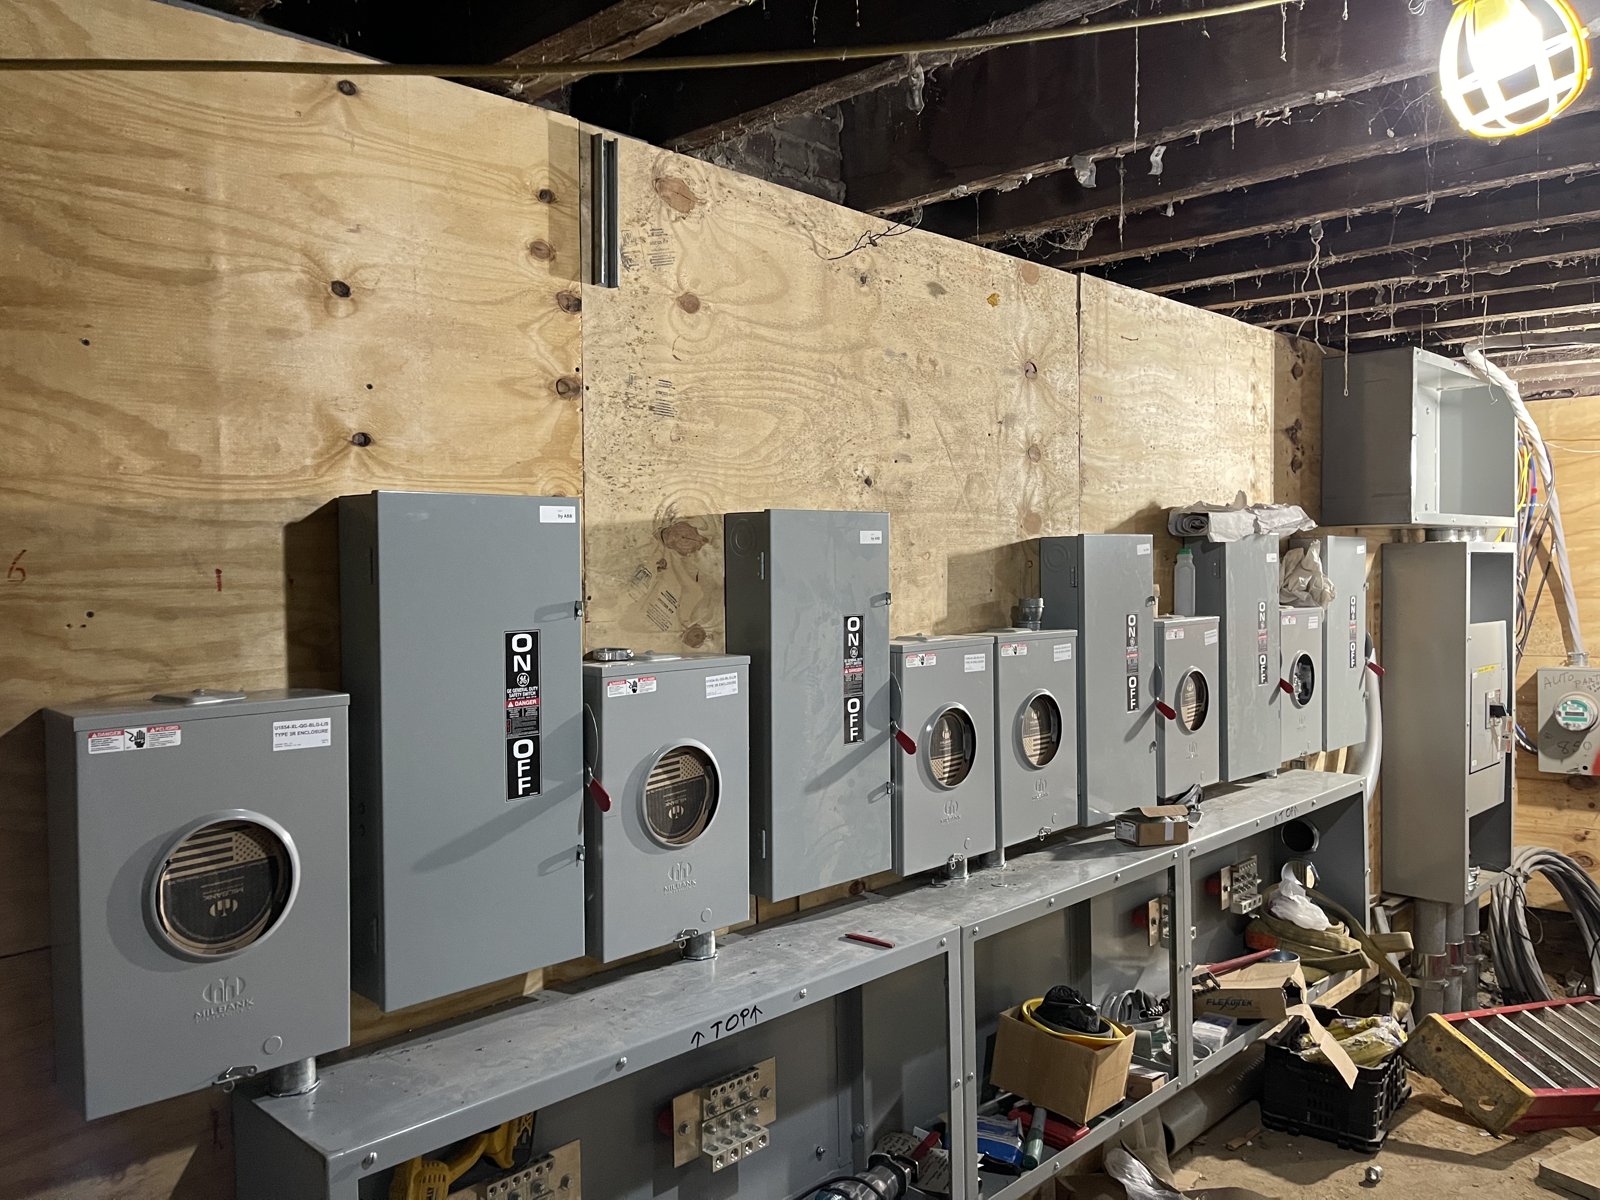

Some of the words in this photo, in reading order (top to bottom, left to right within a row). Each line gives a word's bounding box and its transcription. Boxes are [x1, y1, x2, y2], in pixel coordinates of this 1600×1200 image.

[1128, 614, 1136, 637] ON
[1259, 602, 1266, 621] ON
[847, 616, 860, 647] ON
[511, 633, 533, 672] ON
[1259, 654, 1267, 684] OFF
[1543, 672, 1574, 689] AUTO
[514, 699, 537, 707] DANGER
[1128, 676, 1137, 710] OFF
[297, 728, 329, 736] ENCLOSURE
[847, 697, 861, 742] OFF
[513, 738, 534, 796] OFF
[194, 998, 255, 1018] MILBANK
[710, 1008, 750, 1039] TOP
